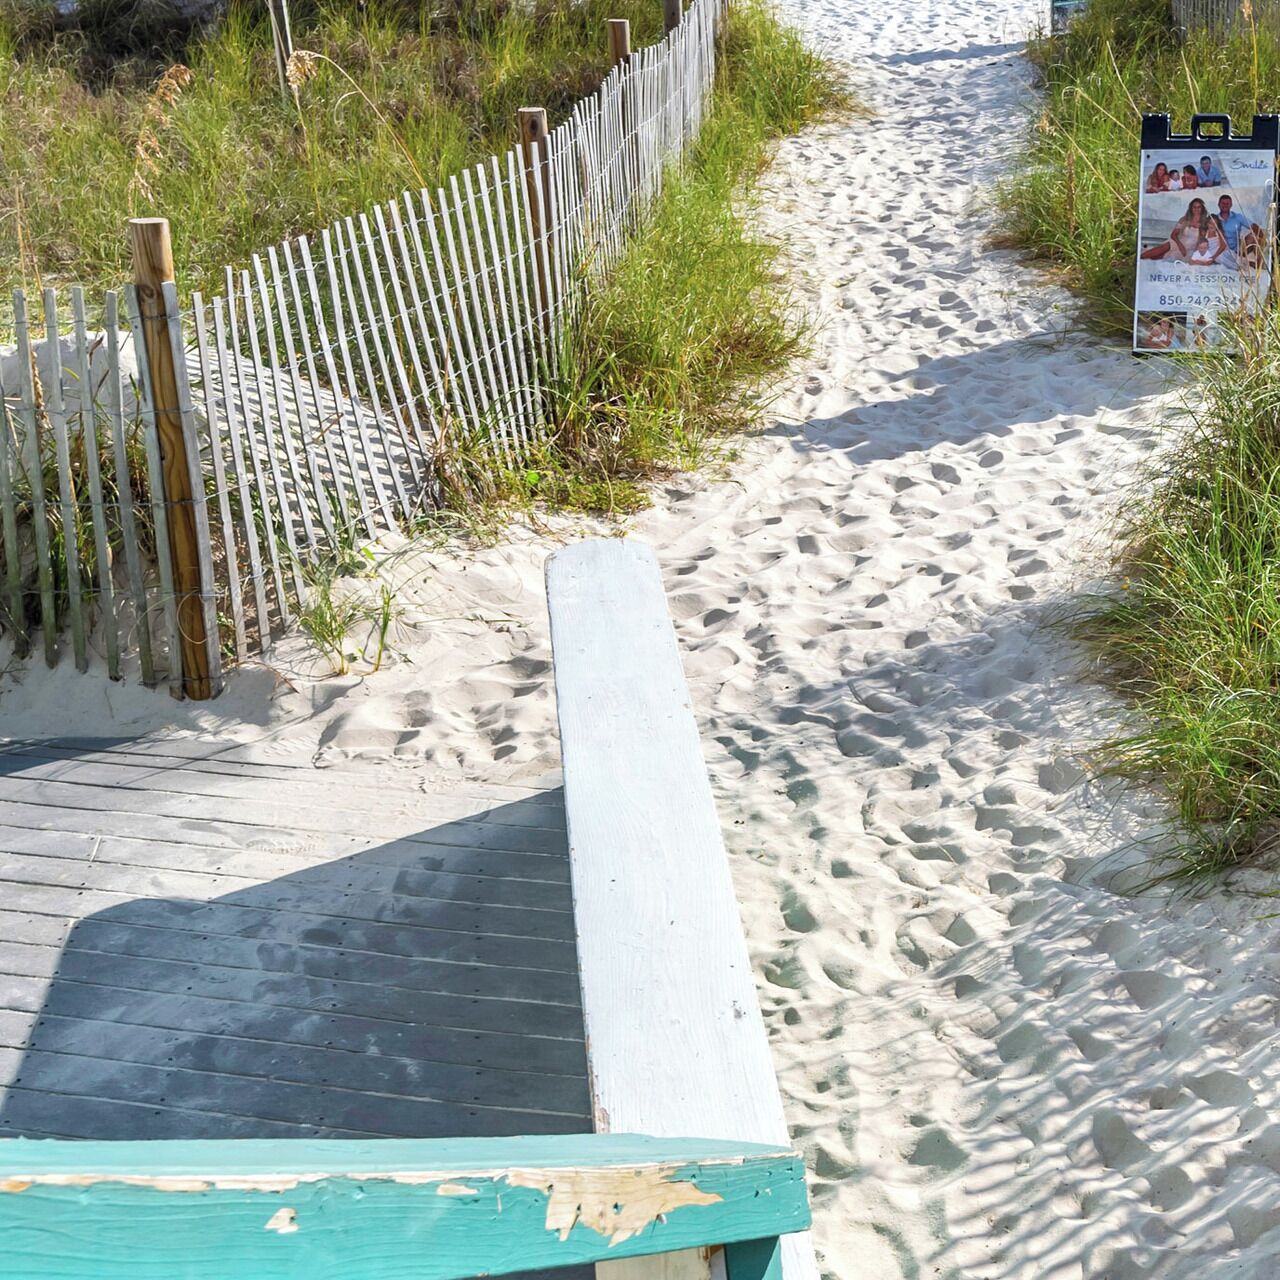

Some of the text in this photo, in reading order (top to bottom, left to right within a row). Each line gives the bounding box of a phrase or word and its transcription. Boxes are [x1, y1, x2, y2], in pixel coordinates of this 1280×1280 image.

[1149, 273, 1181, 283] NEVER
[1184, 274, 1192, 283] A
[1194, 274, 1236, 284] SESSION
